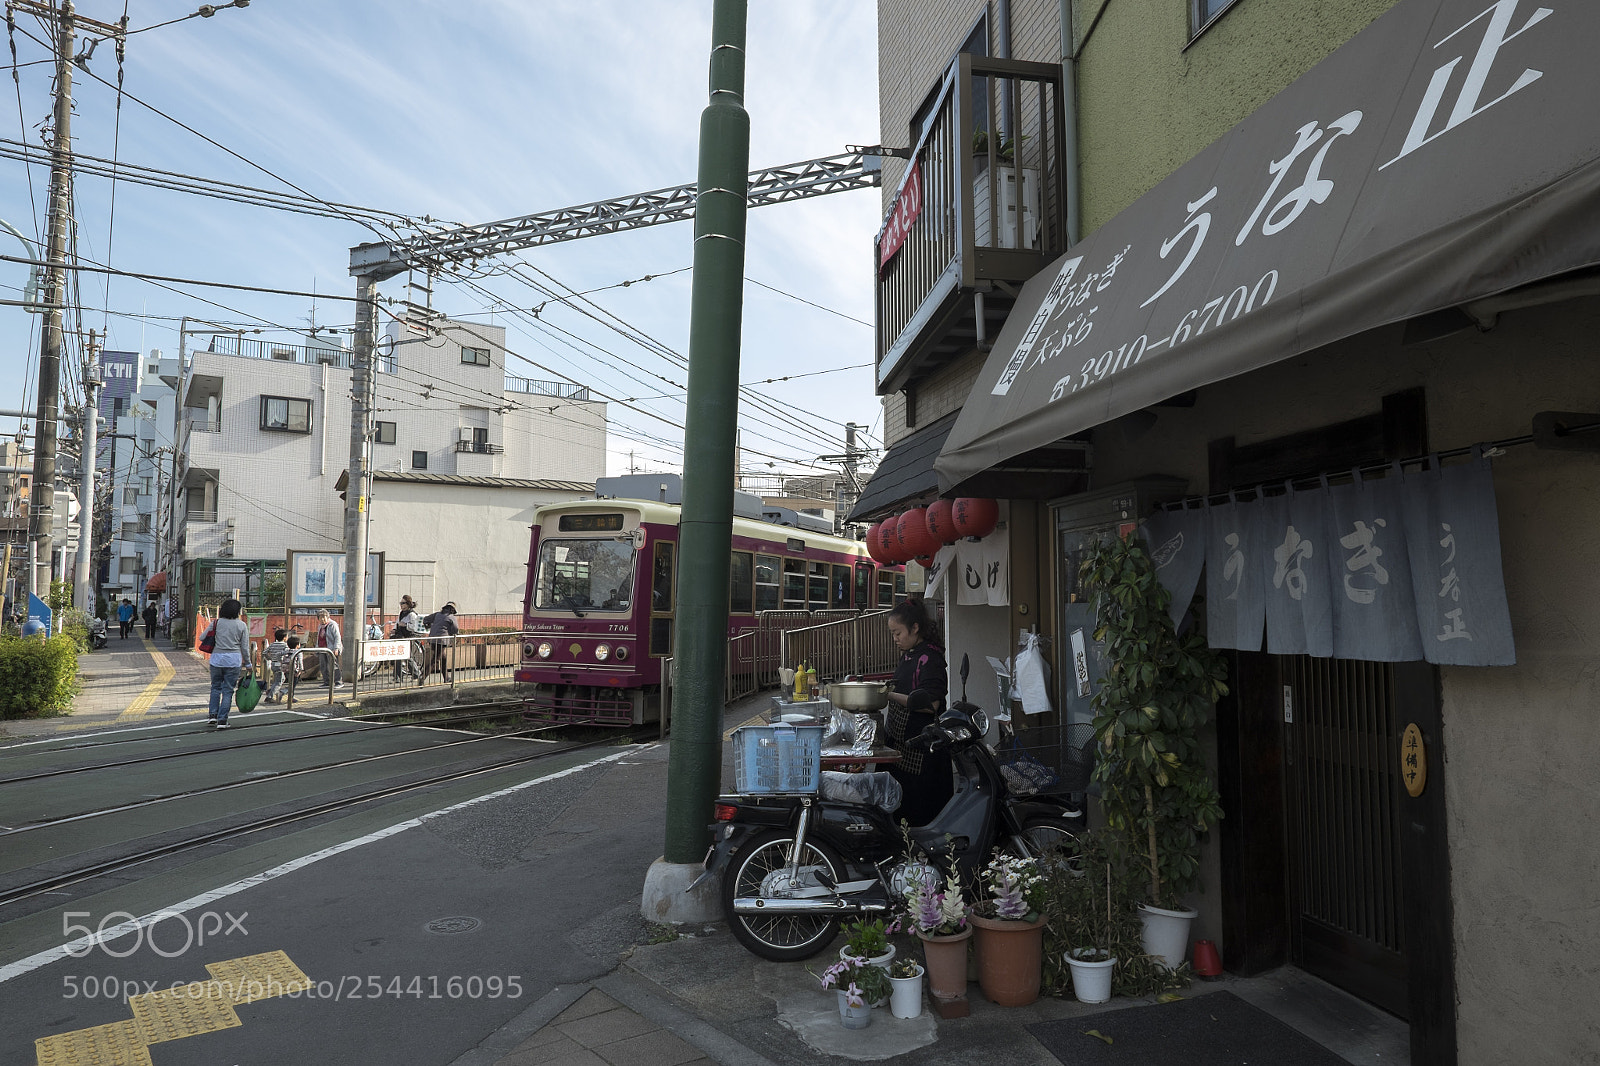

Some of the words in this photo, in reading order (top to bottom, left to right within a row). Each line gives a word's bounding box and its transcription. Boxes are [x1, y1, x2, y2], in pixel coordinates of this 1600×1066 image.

[885, 173, 919, 256] やきとり
[1053, 244, 1131, 322] うなぎ
[1000, 267, 1073, 386] 味自慢
[1026, 305, 1100, 373] 天ぷら
[1223, 518, 1390, 605] うなぎ
[369, 645, 405, 657] 電車注意
[608, 624, 630, 632] 7706
[1406, 730, 1418, 784] 準備中
